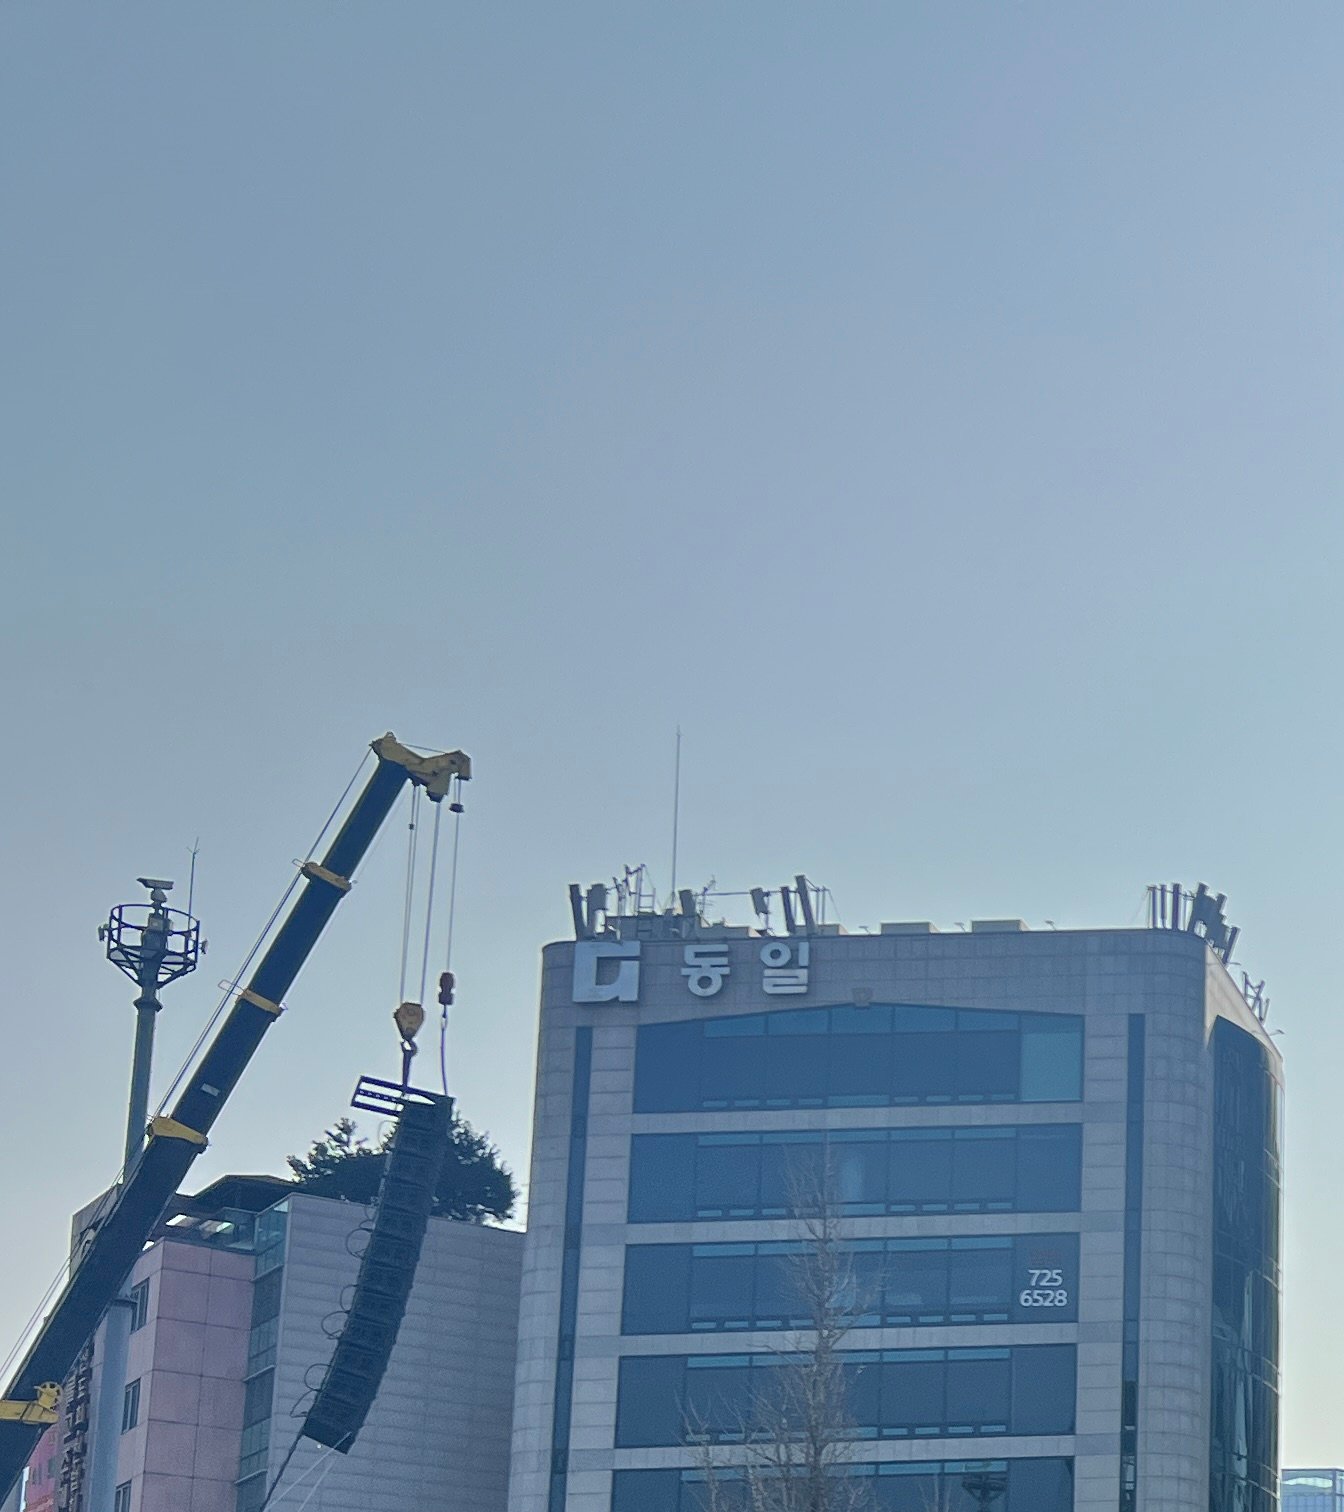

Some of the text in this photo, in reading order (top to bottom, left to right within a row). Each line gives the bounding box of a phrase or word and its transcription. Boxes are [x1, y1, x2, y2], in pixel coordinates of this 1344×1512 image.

[679, 939, 812, 997] 동일
[1028, 1268, 1063, 1287] 725
[1019, 1288, 1069, 1308] 6528
